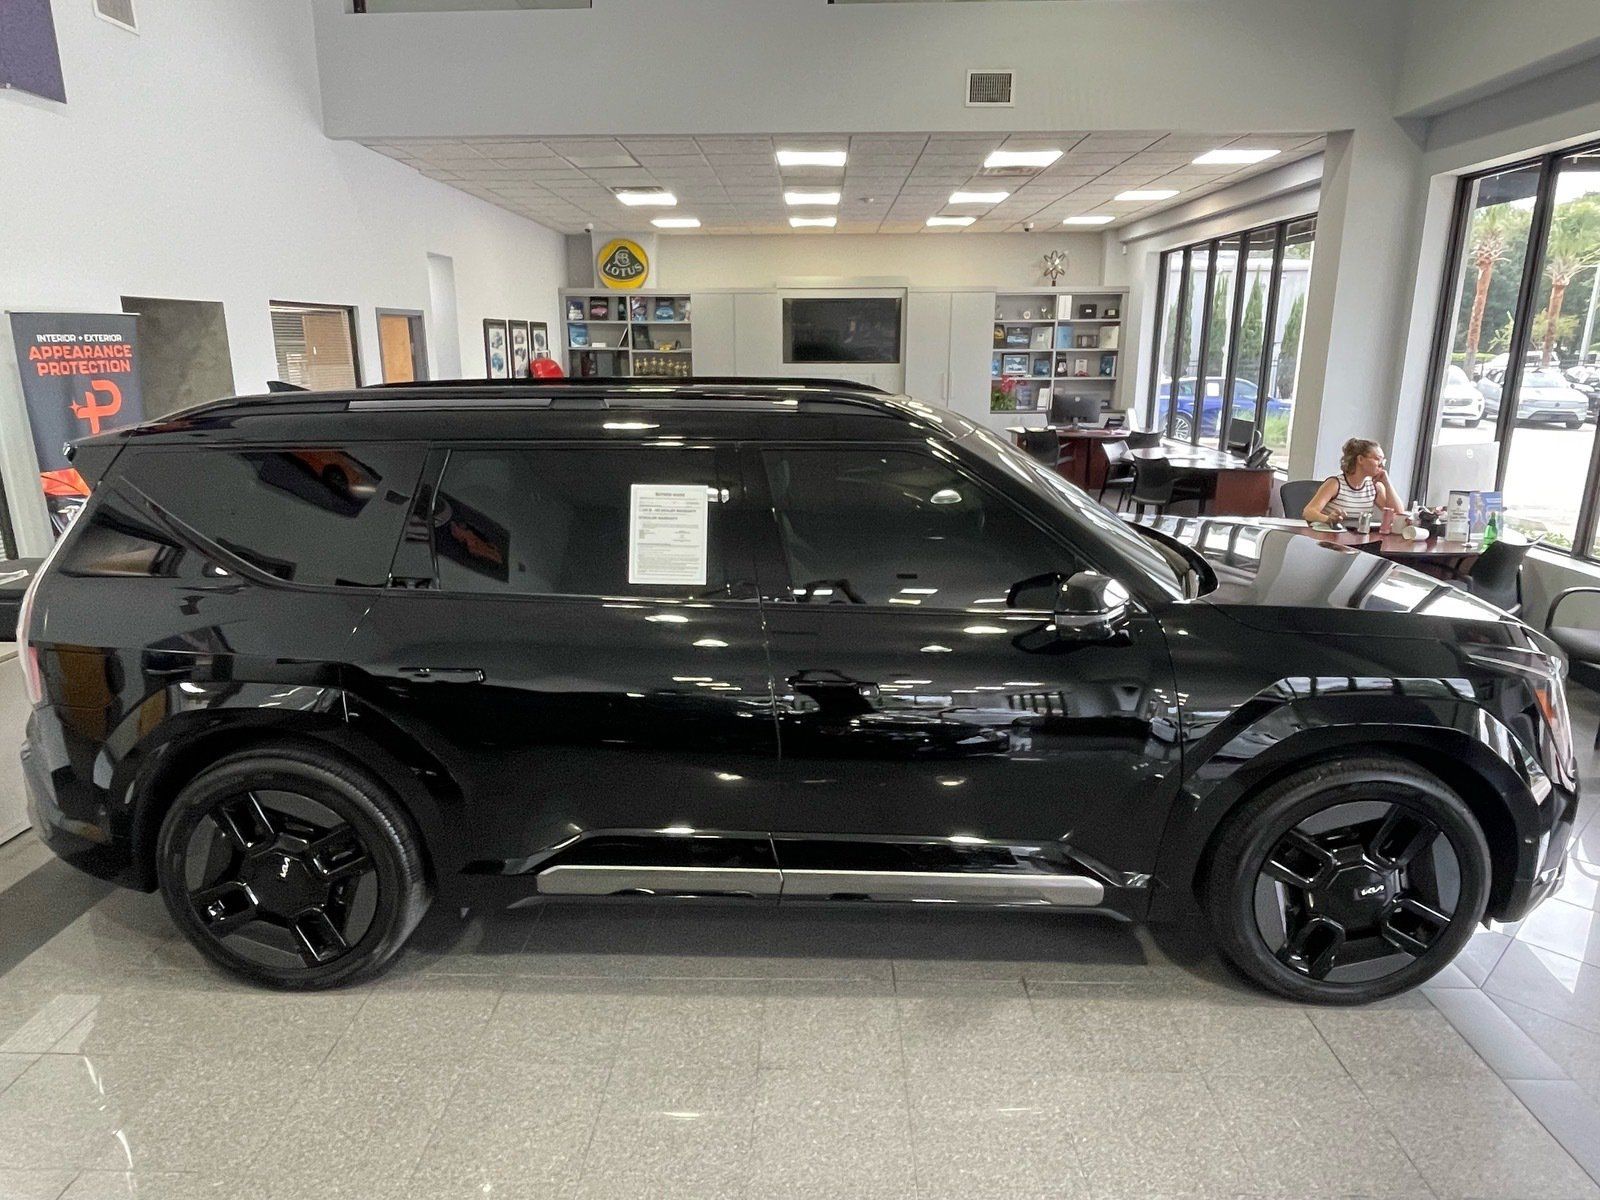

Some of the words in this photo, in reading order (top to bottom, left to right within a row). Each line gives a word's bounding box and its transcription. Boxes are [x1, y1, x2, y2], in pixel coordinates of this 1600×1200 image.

[605, 263, 643, 277] LOTUS
[36, 334, 76, 342] INTERIOR
[84, 334, 122, 342] EXTERIOR
[29, 345, 132, 360] APPEARANCE
[37, 360, 131, 376] PROTECTION
